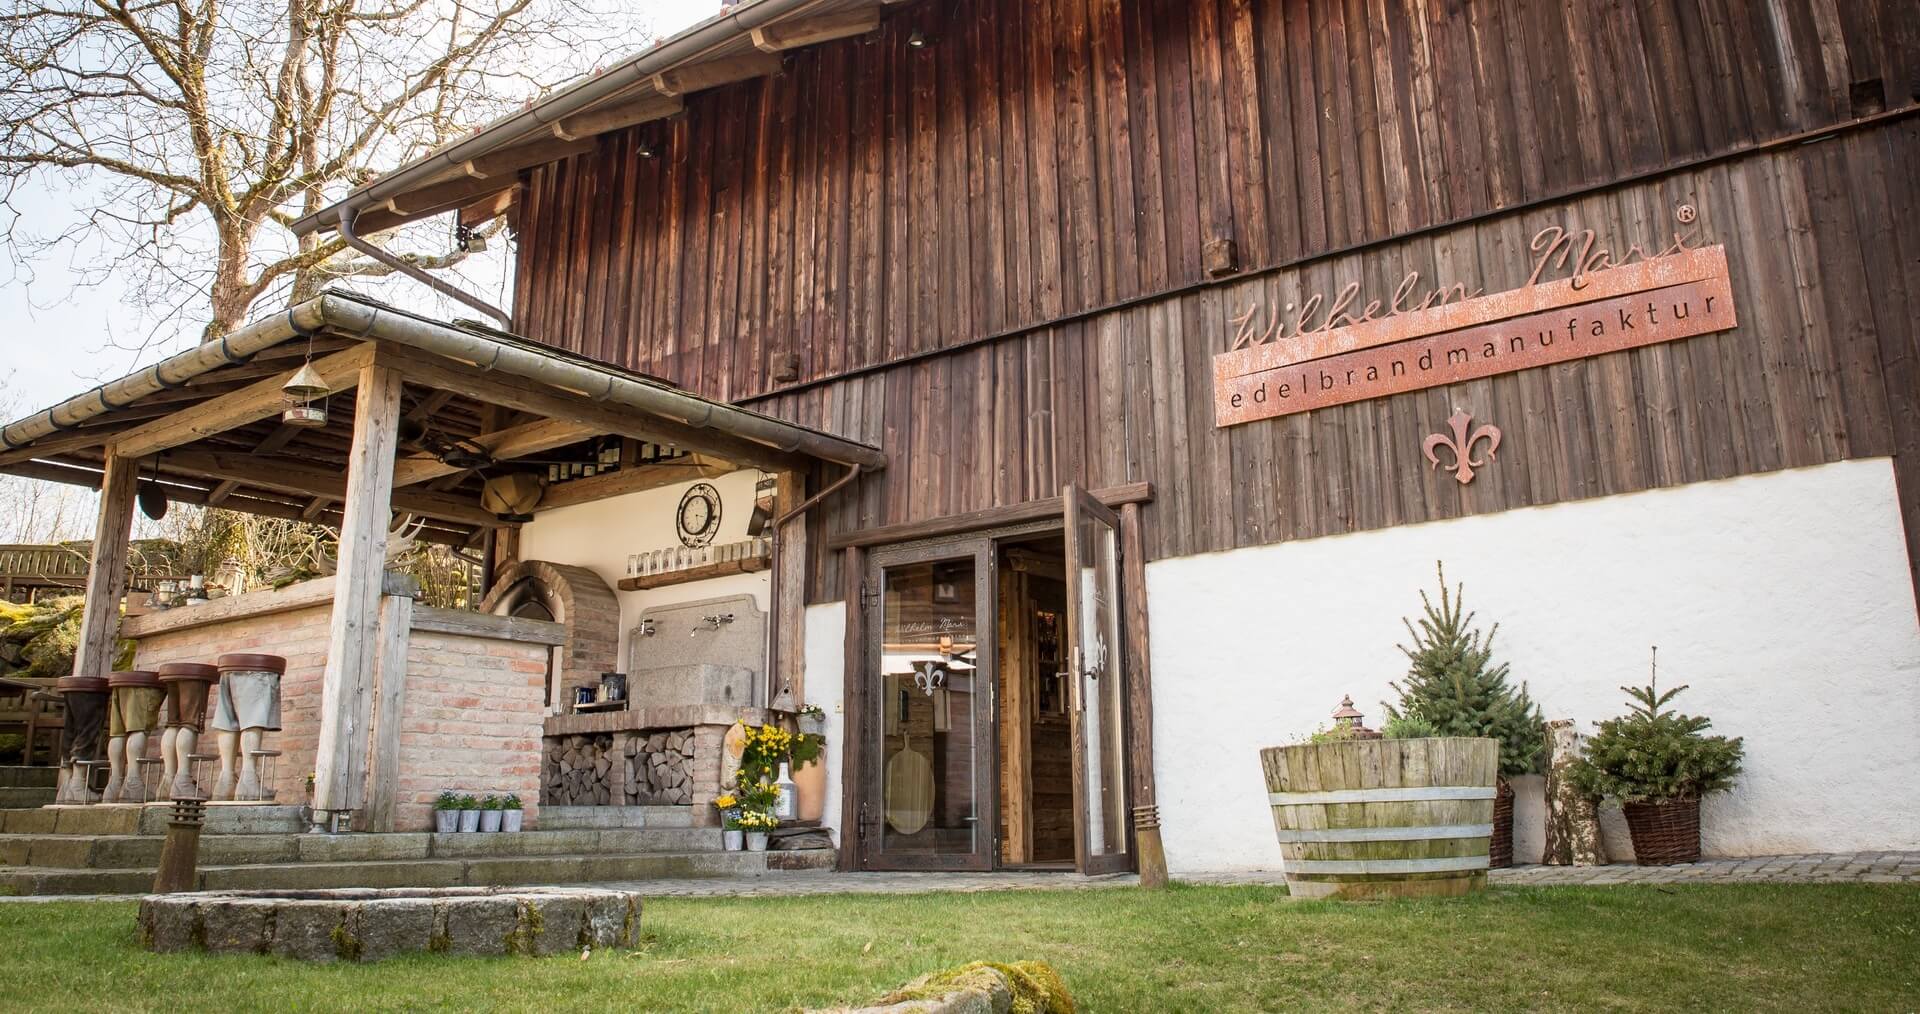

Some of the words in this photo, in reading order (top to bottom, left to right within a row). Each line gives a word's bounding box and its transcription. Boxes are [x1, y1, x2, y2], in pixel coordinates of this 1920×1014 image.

[1228, 271, 1483, 352] Wilhelm
[1528, 226, 1706, 290] Marx
[1230, 294, 1716, 409] edelbrandmanufaktur
